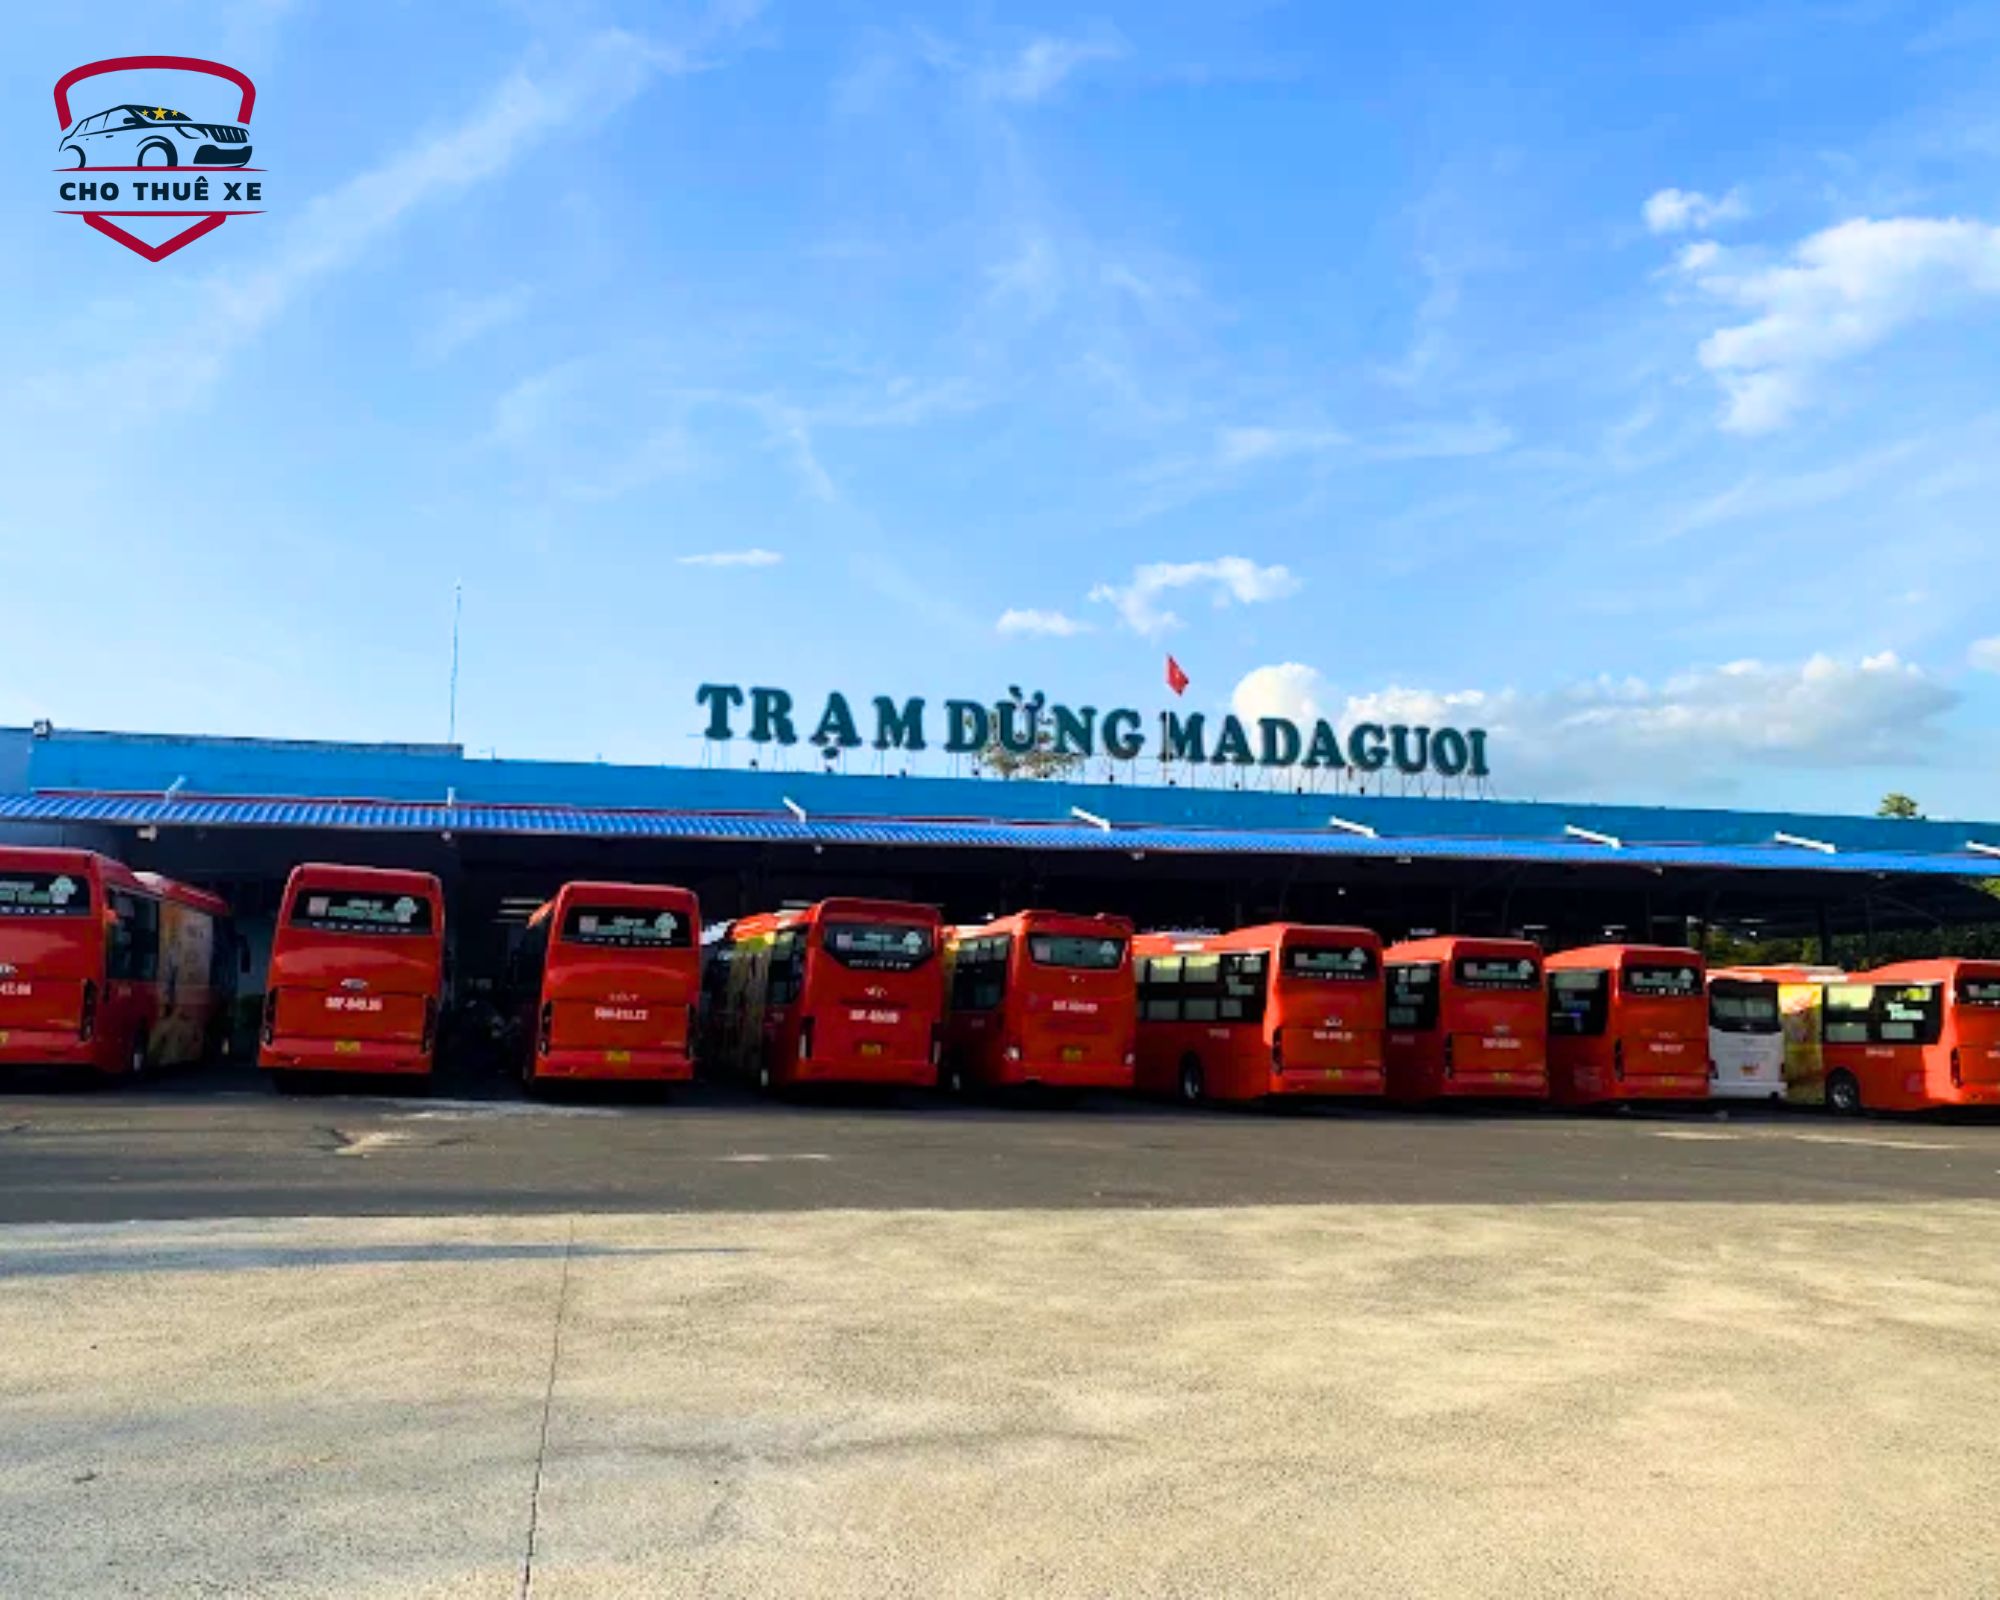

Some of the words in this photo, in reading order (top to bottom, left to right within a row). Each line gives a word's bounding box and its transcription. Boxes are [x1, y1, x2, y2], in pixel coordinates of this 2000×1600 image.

[696, 683, 927, 760] TRẠM
[944, 684, 1145, 761] DỪNG
[1157, 710, 1490, 777] MADAGUOI
